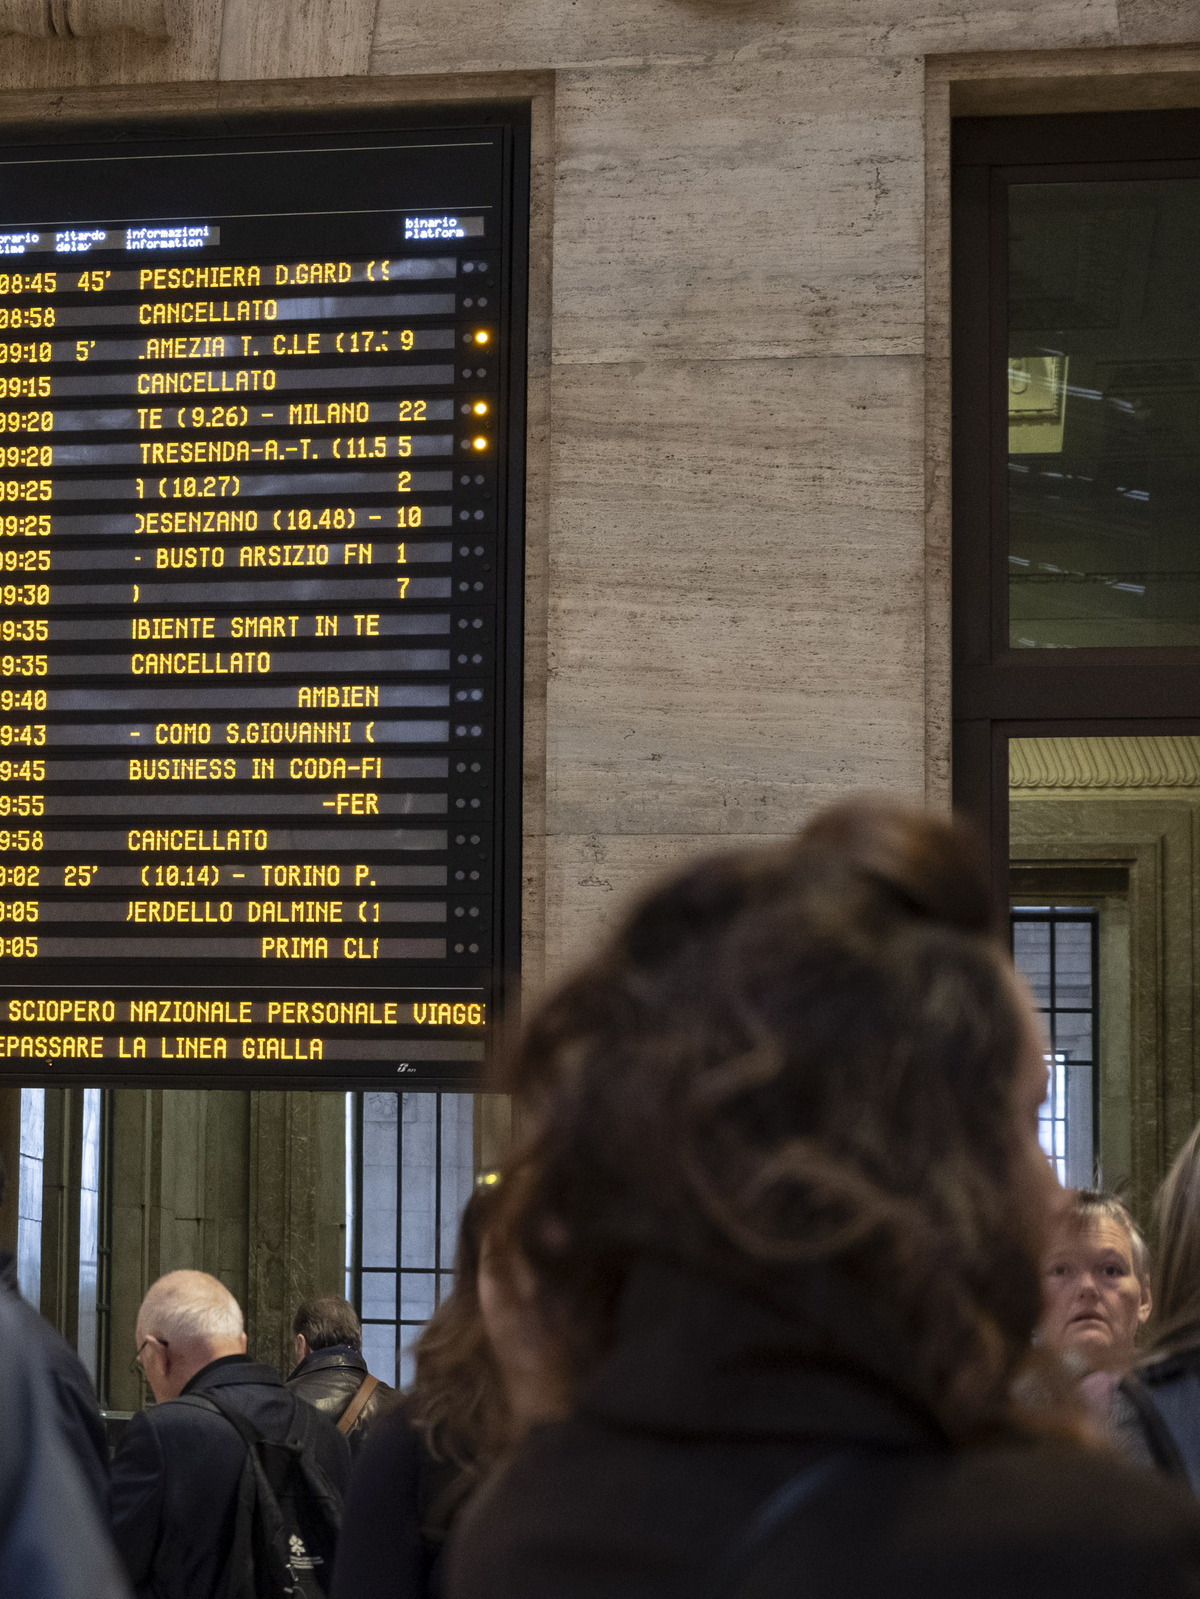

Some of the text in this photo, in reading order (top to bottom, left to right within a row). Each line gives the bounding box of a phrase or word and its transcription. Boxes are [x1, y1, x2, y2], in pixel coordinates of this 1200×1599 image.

[56, 229, 107, 242] ritardo
[126, 225, 210, 239] informazioni
[405, 216, 458, 229] binario
[126, 237, 204, 250] information
[405, 227, 465, 239] platform
[139, 265, 261, 290] PESCHIERA
[275, 262, 352, 286] D.GARD
[138, 299, 278, 325] CANCELLATO
[272, 333, 321, 356] C.LE
[400, 329, 414, 351] 9
[137, 369, 276, 395] CANCELLATO
[137, 407, 163, 430] TE
[288, 401, 370, 426] MILANO
[398, 400, 427, 422] 22
[397, 435, 412, 458] 5
[397, 470, 412, 493] 2
[396, 505, 422, 528] 10
[156, 546, 225, 569] BUSTO
[239, 544, 330, 567] ARSIZIO
[344, 543, 373, 565] FN
[396, 542, 407, 564] 1
[396, 577, 410, 599] 7
[230, 615, 300, 638] SMART
[314, 615, 338, 637] IN
[353, 614, 380, 636] TE
[131, 651, 271, 675] CANCELLATO
[297, 685, 379, 708] AMBIEN
[155, 722, 212, 745] COMO
[226, 721, 352, 744] S.GIOVANNI
[128, 758, 237, 781] BUSINESS
[251, 758, 275, 780] IN
[127, 829, 268, 851] CANCELLATO
[261, 864, 341, 887] TORINO
[247, 901, 343, 923] DALMINE
[261, 936, 328, 959] PRIMA
[8, 999, 116, 1022] SCIOPERO
[129, 1000, 253, 1023] NAZIONALE
[267, 1001, 398, 1025] PERSONALE
[118, 1036, 147, 1059] LA
[161, 1036, 227, 1059] LINEA
[241, 1037, 323, 1060] GIALLA
